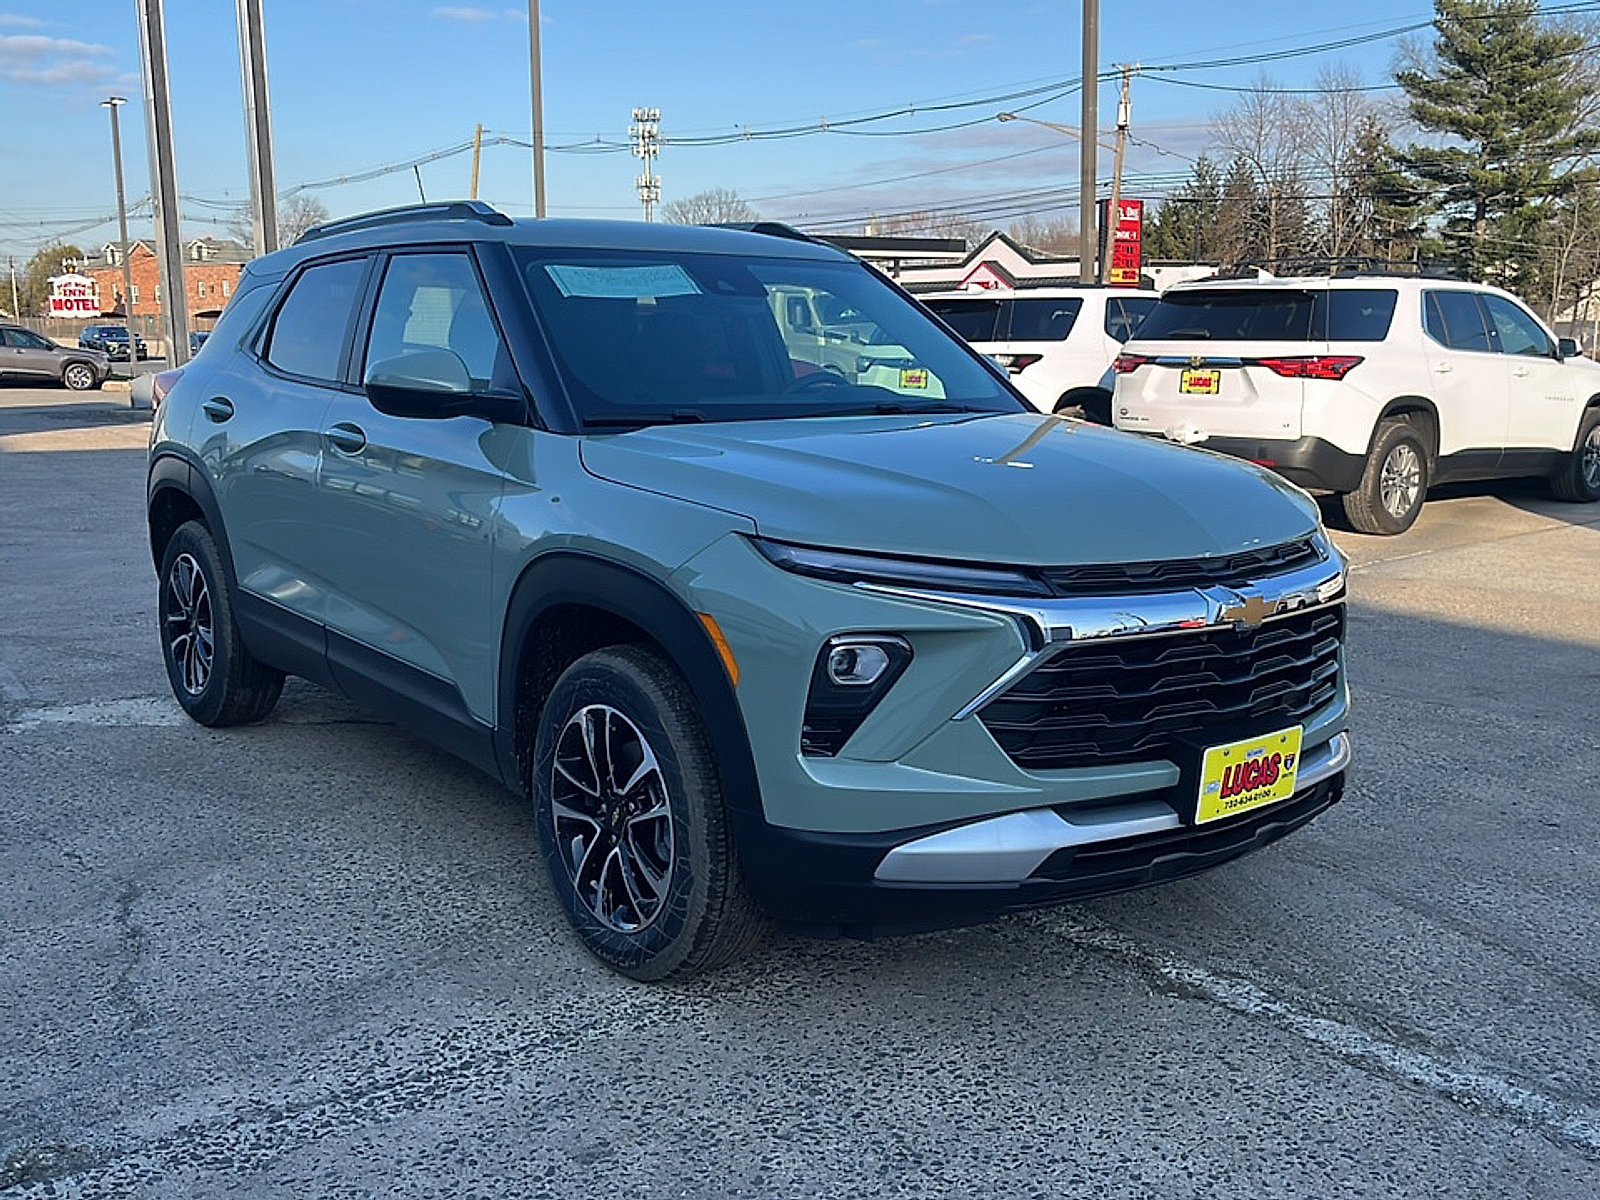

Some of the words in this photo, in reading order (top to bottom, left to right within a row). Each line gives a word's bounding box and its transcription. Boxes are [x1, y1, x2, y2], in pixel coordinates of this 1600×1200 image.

[52, 299, 99, 311] MOTEL
[1189, 376, 1212, 387] LUCAS
[1220, 752, 1281, 799] LUCAS
